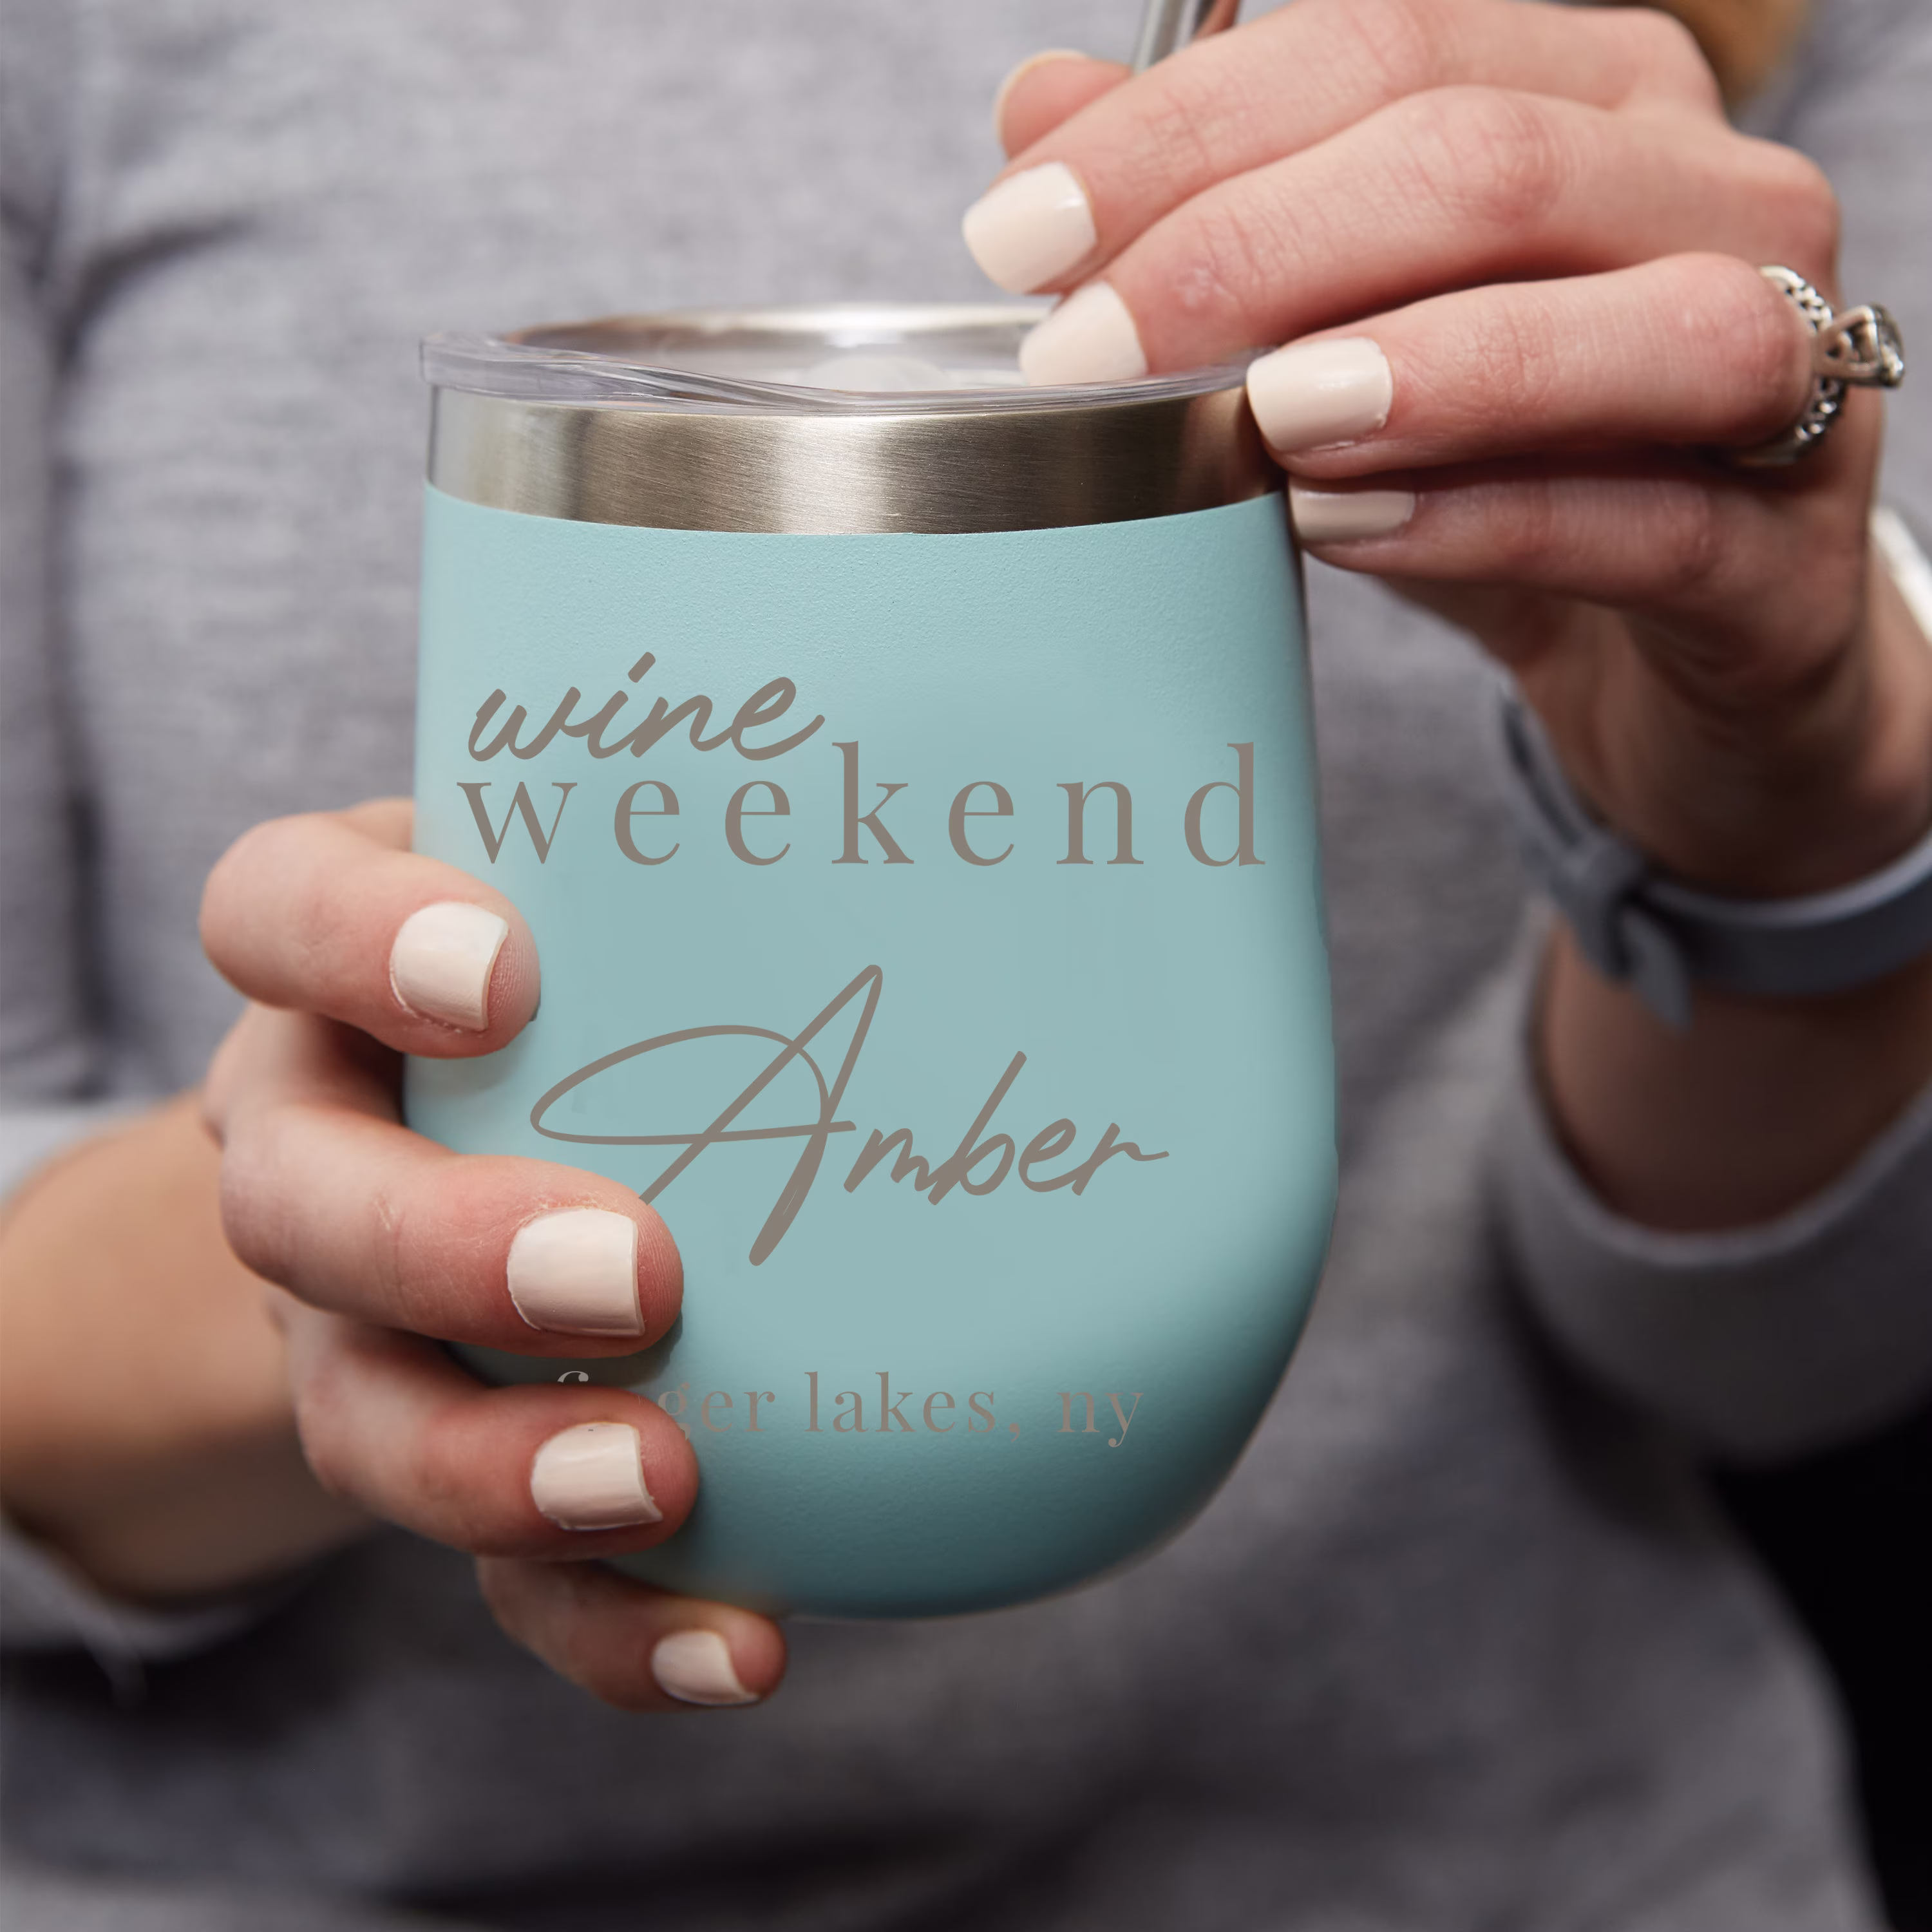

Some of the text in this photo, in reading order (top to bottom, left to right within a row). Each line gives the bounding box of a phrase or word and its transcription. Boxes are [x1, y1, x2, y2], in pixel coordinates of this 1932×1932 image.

[468, 651, 825, 762] wine
[457, 741, 1266, 867] weekend
[530, 965, 1170, 1267] Amber
[557, 1370, 1144, 1447] ger lakes, ny
